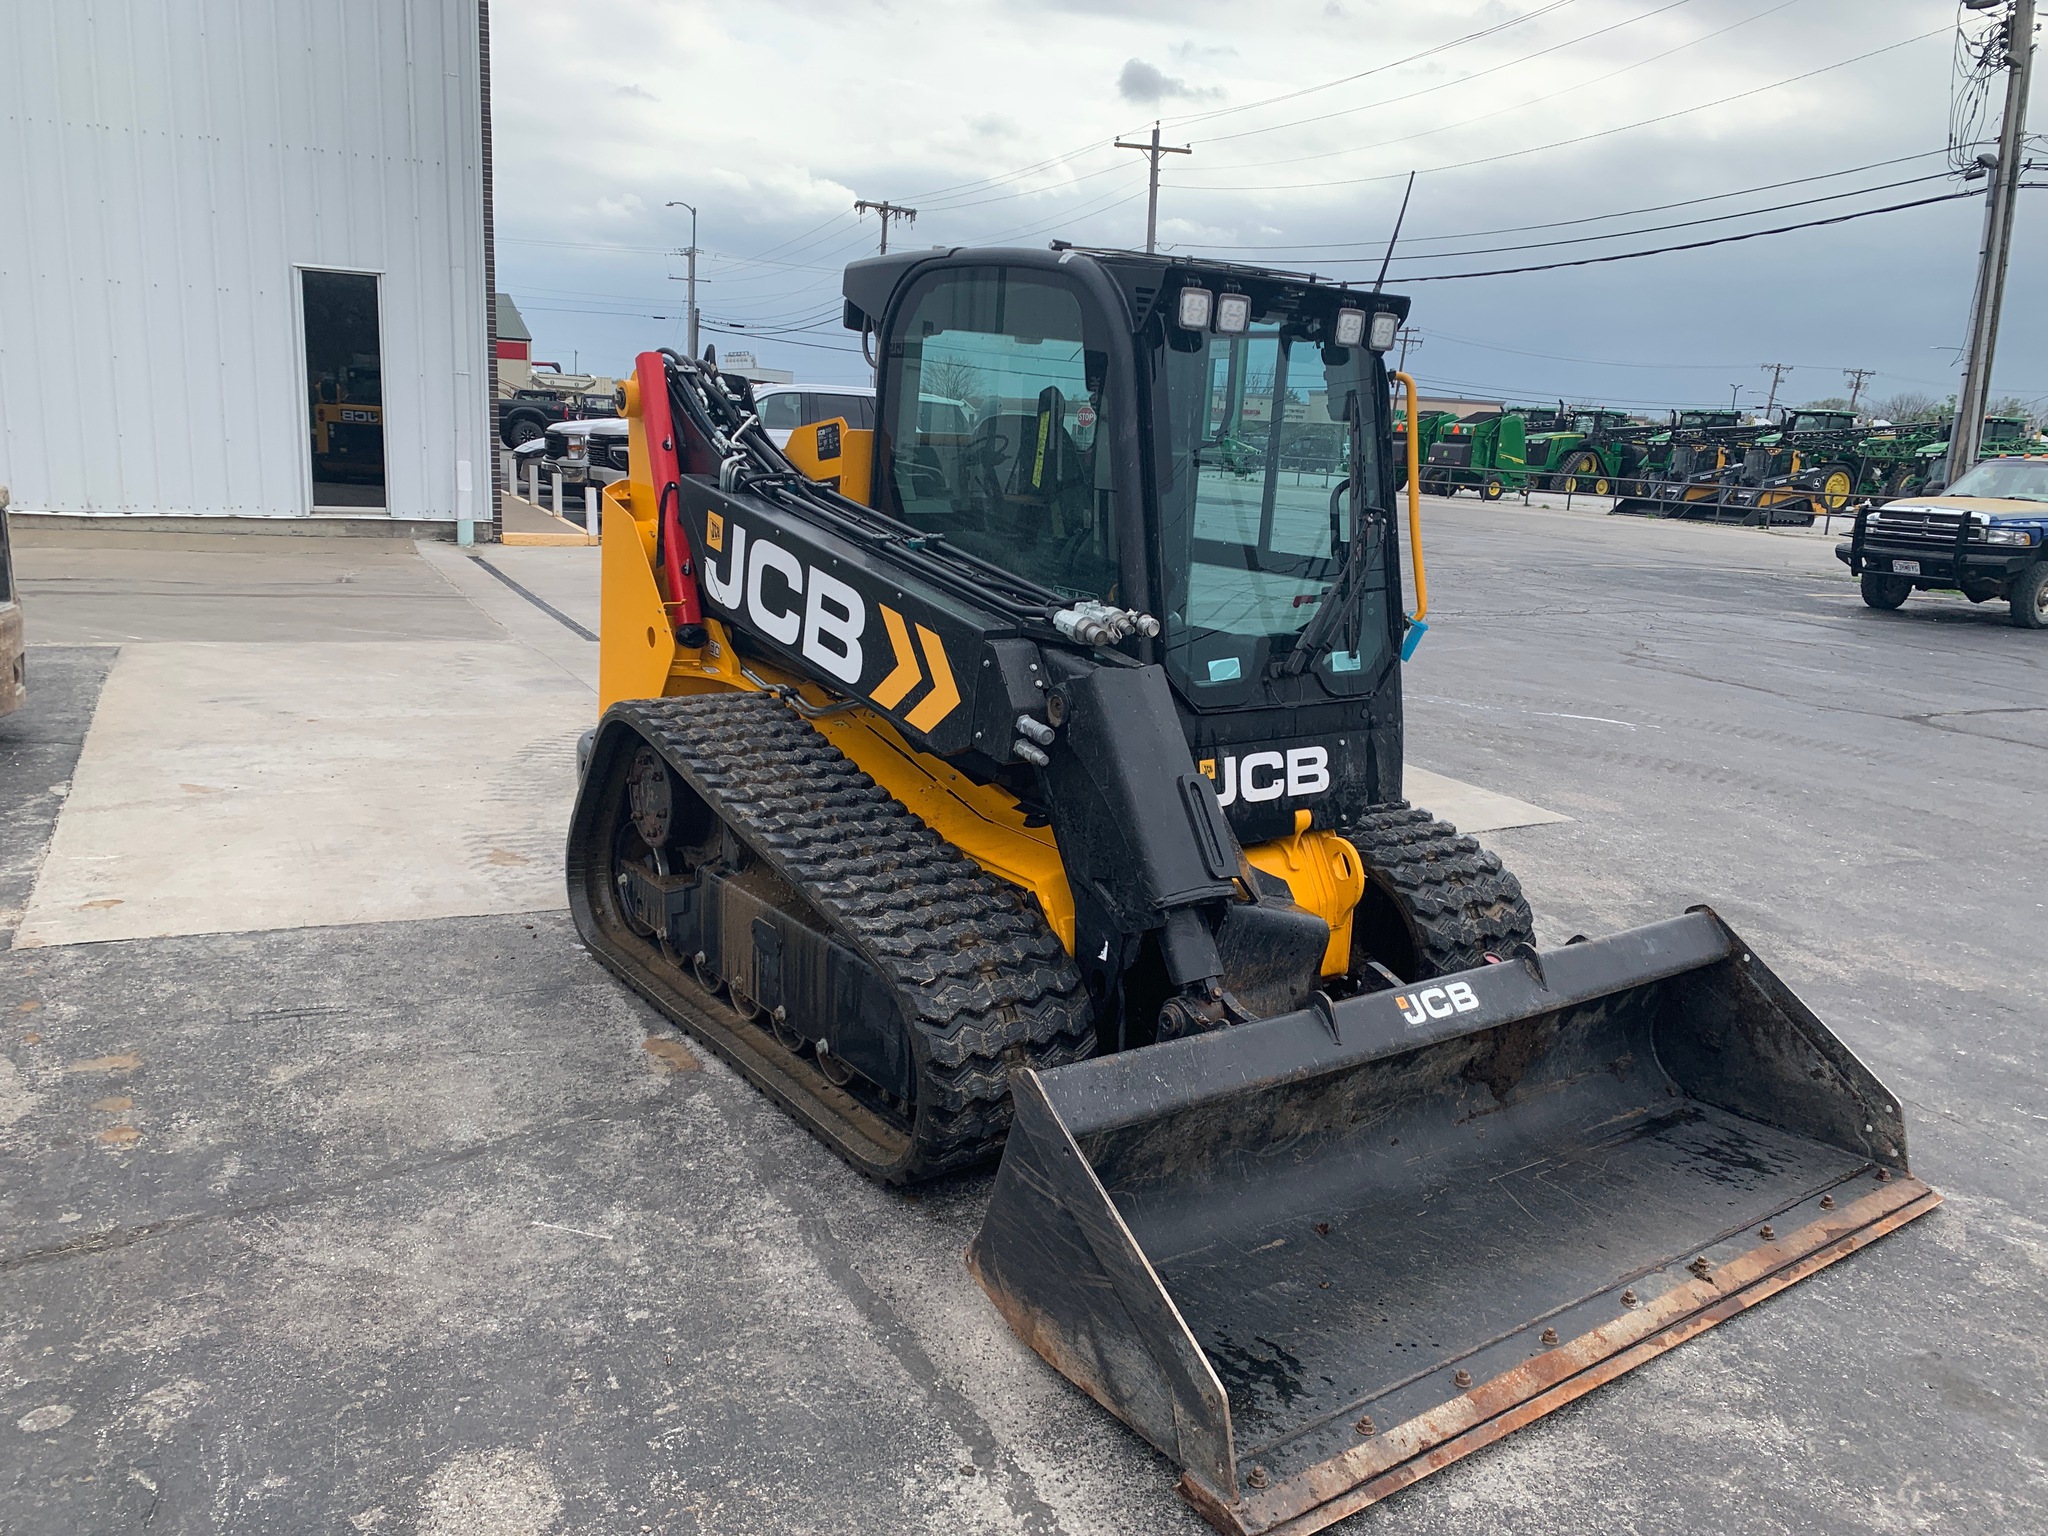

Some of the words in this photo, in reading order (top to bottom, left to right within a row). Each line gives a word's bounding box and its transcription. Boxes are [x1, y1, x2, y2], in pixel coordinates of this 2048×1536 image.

[1078, 413, 1094, 421] STOP
[705, 523, 866, 685] JCB
[1216, 746, 1330, 807] JCB
[1403, 981, 1480, 1025] JCB
